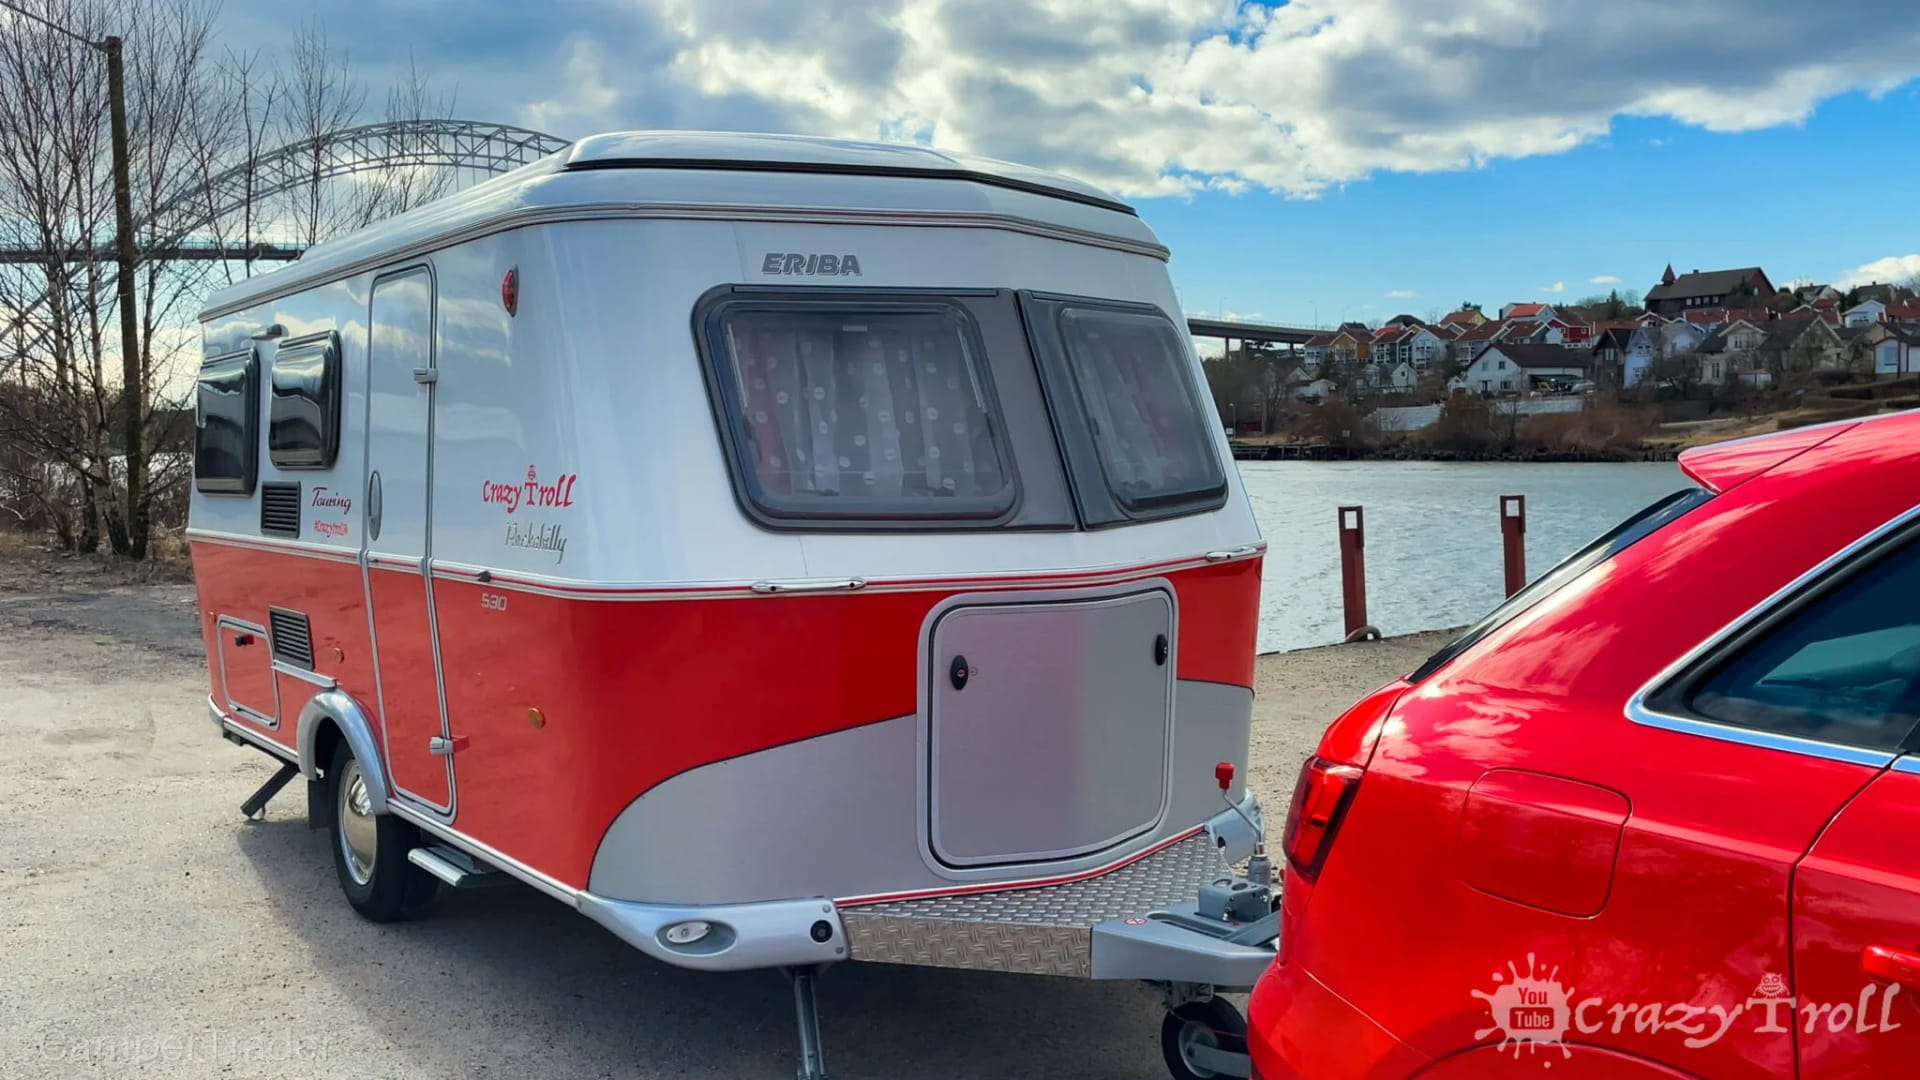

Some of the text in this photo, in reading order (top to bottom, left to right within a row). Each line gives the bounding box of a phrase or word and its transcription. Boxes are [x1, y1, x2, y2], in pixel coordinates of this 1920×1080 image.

[762, 253, 863, 276] ERIBA
[312, 486, 352, 515] Touring
[481, 593, 507, 611] 530
